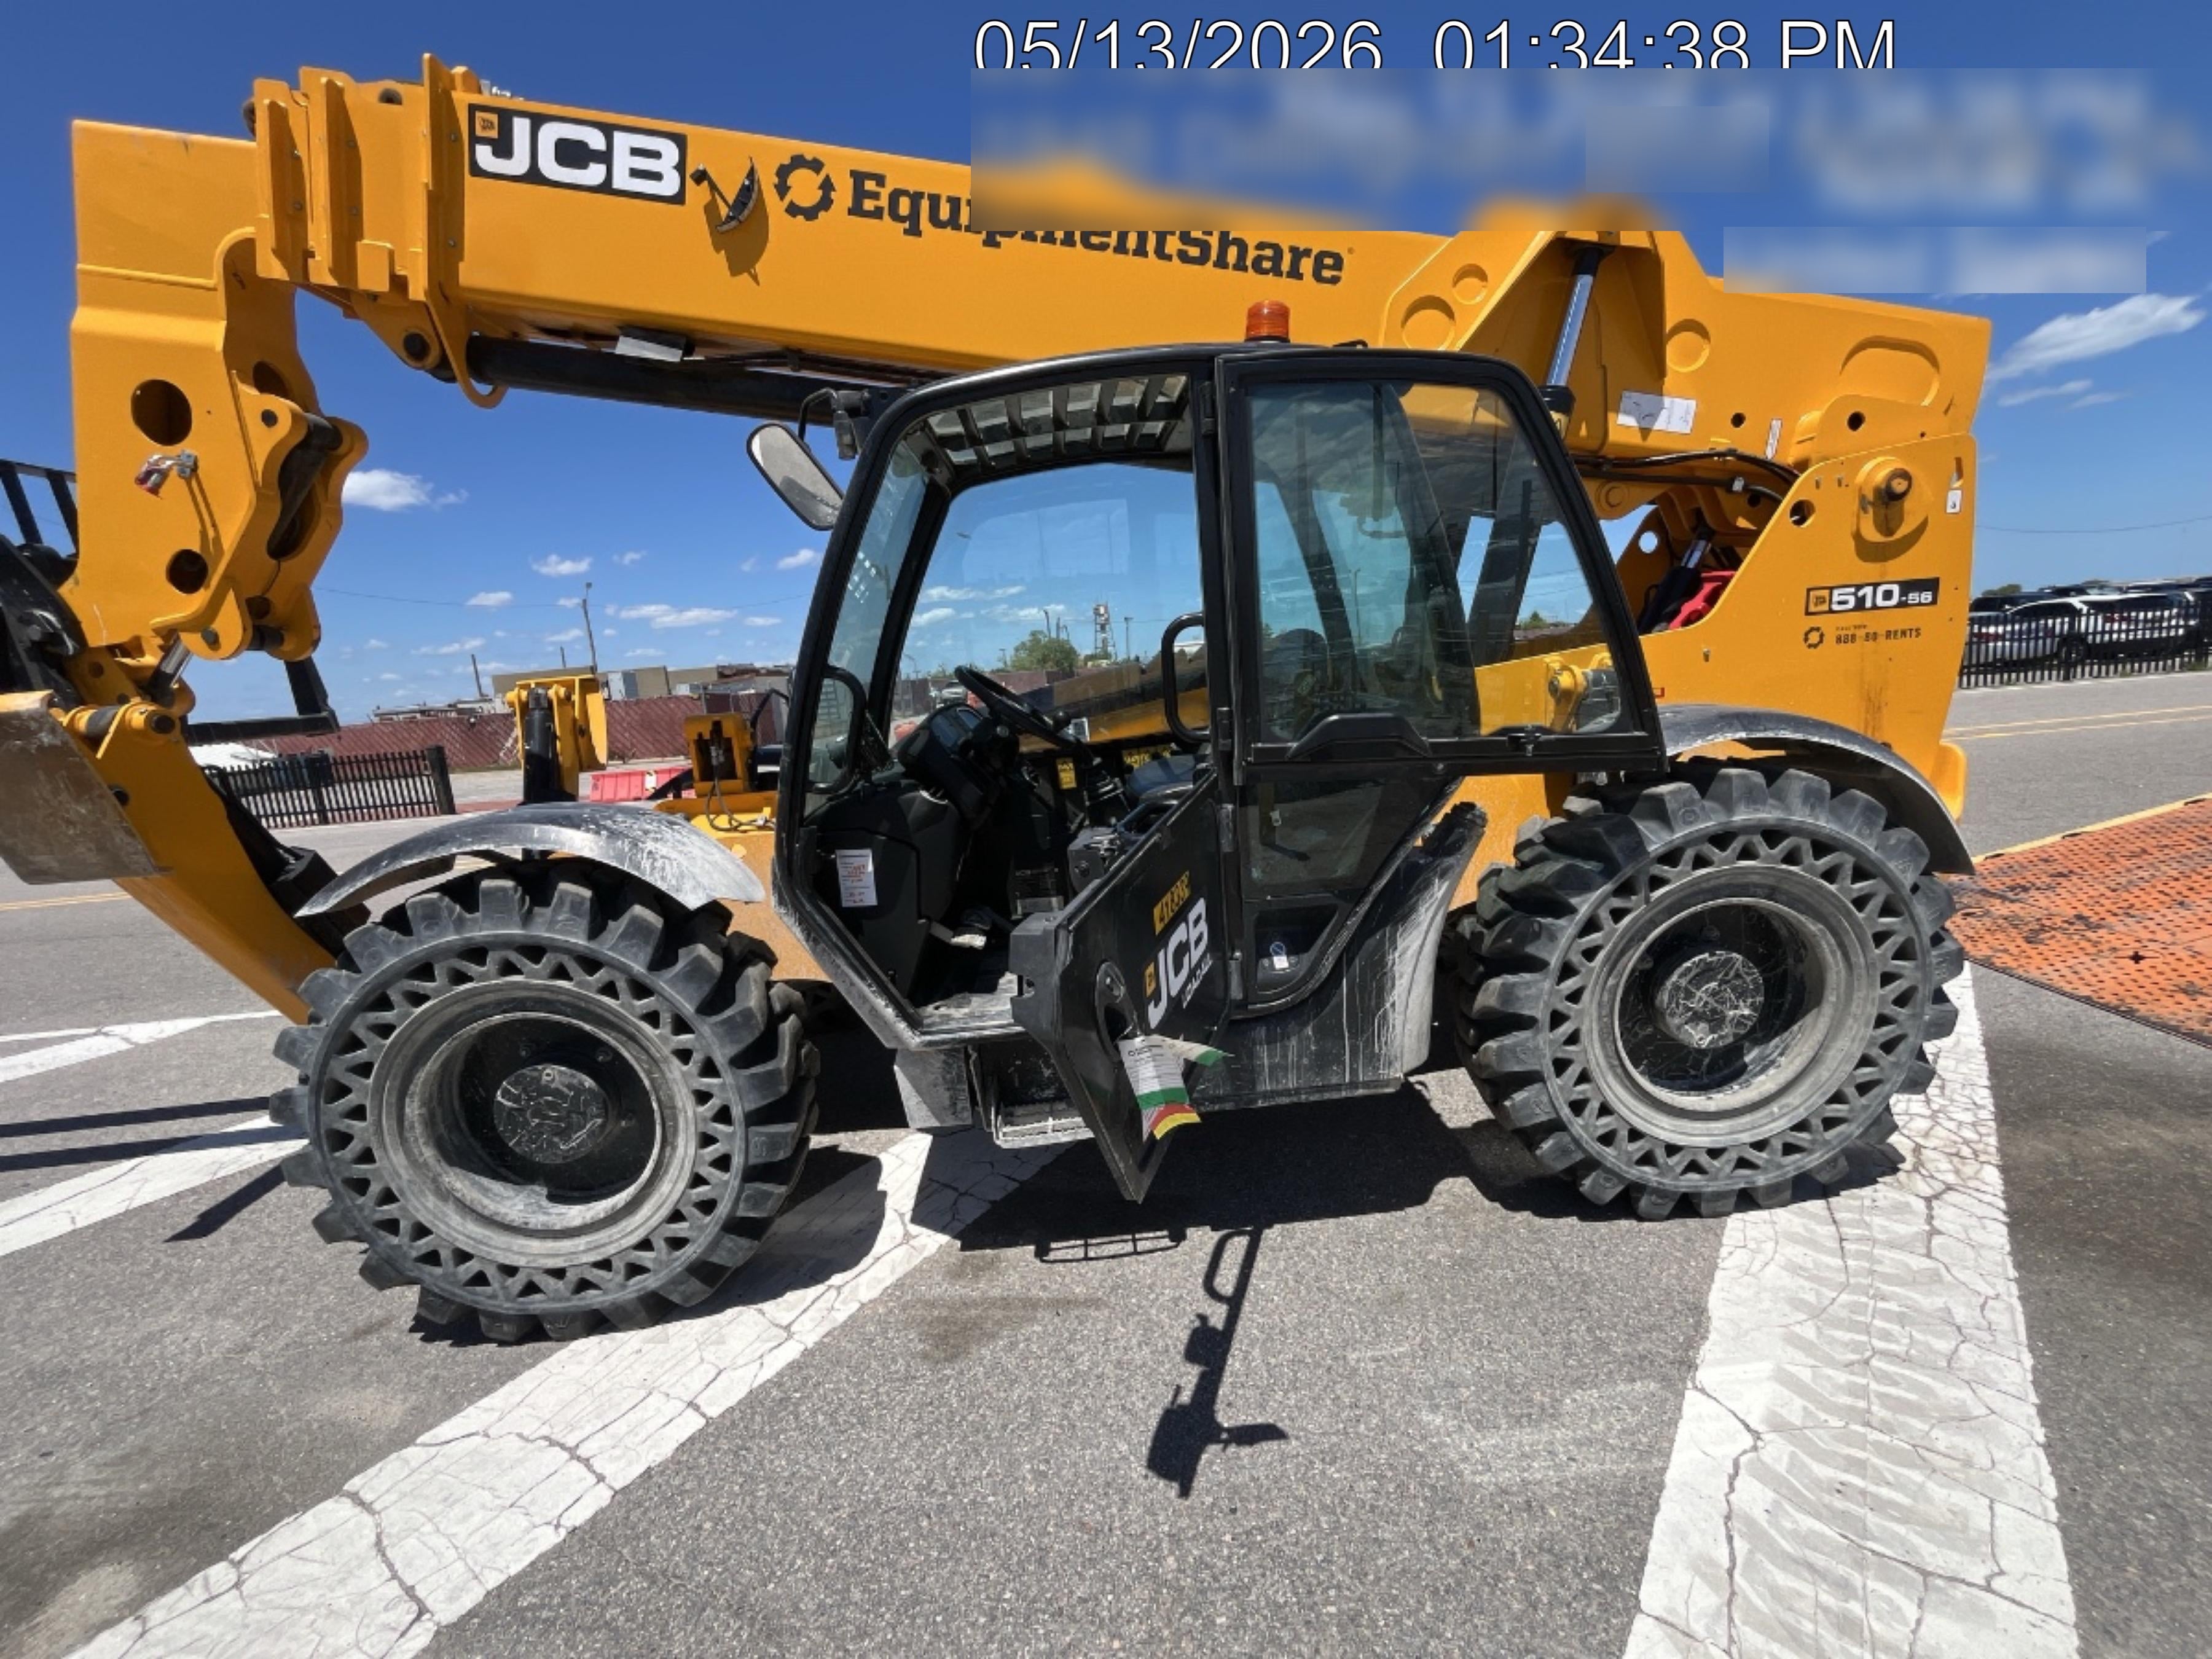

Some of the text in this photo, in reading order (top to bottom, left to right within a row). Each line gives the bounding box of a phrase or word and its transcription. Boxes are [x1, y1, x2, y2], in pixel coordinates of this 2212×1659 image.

[475, 117, 681, 196] JCB
[1831, 584, 1933, 611] 510-56
[1148, 897, 1208, 1029] JCB
